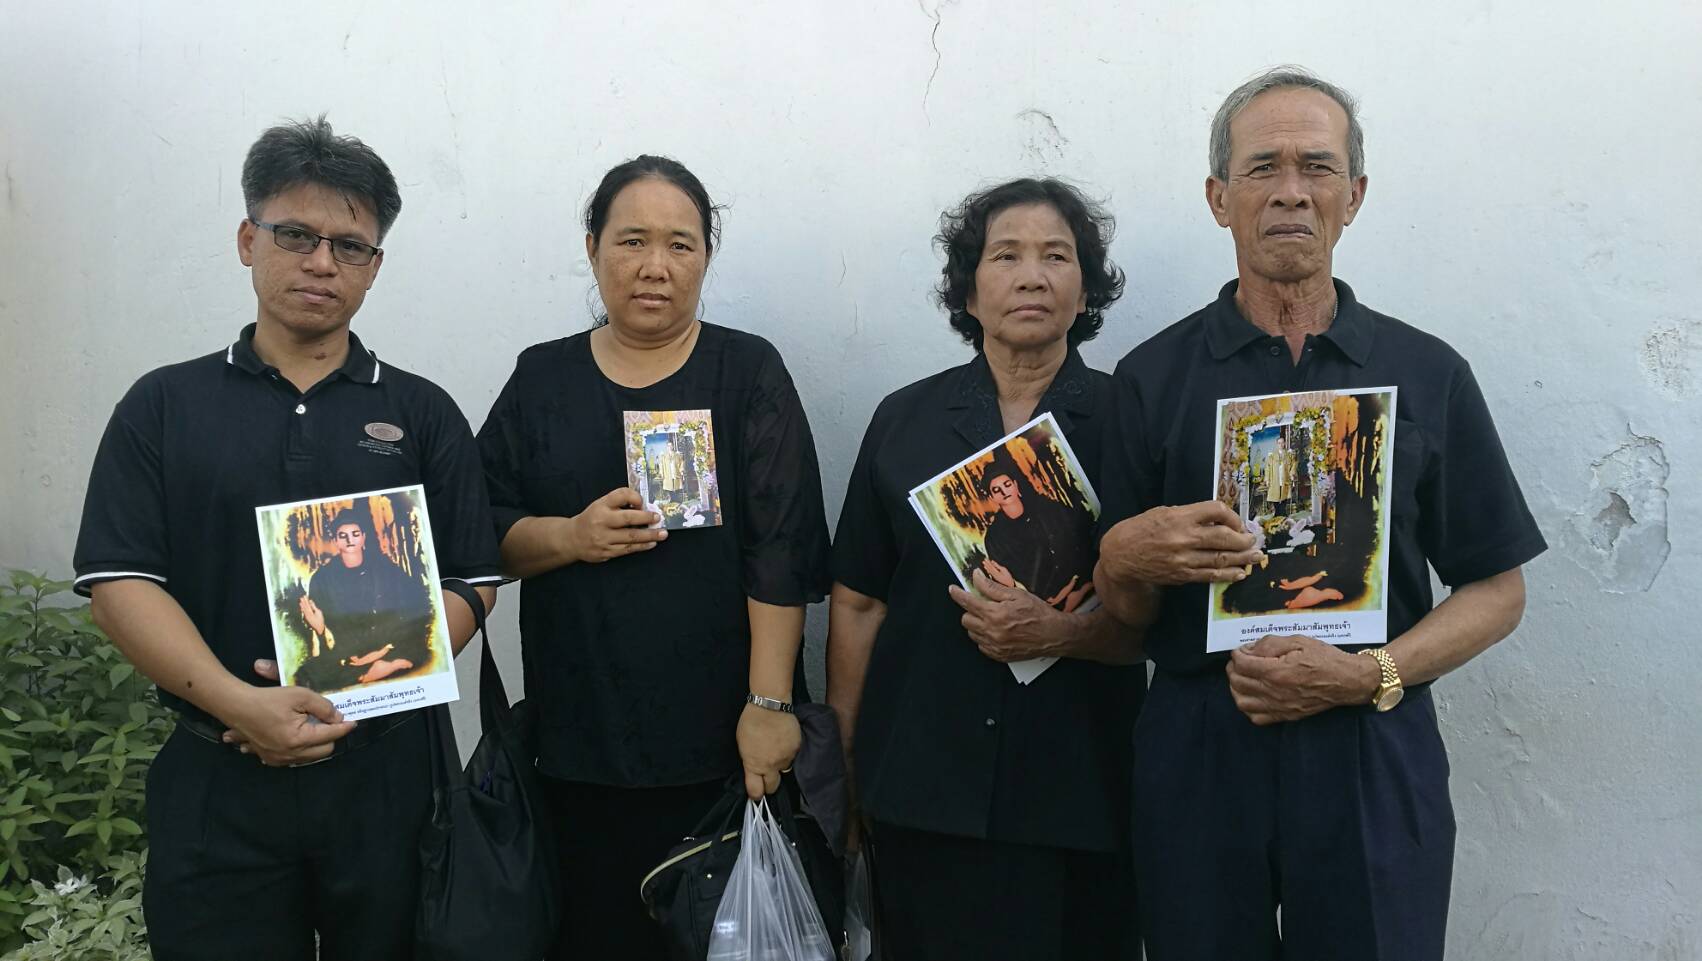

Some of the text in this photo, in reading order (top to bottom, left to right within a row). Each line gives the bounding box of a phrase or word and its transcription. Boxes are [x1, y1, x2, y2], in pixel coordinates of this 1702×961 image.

[1241, 621, 1351, 634] องค์สมเด็จพระสัมมาสัมพุทธเจ้า
[336, 686, 425, 710] สมเด็จพระสัมมาสัมพุทธเจ้า
